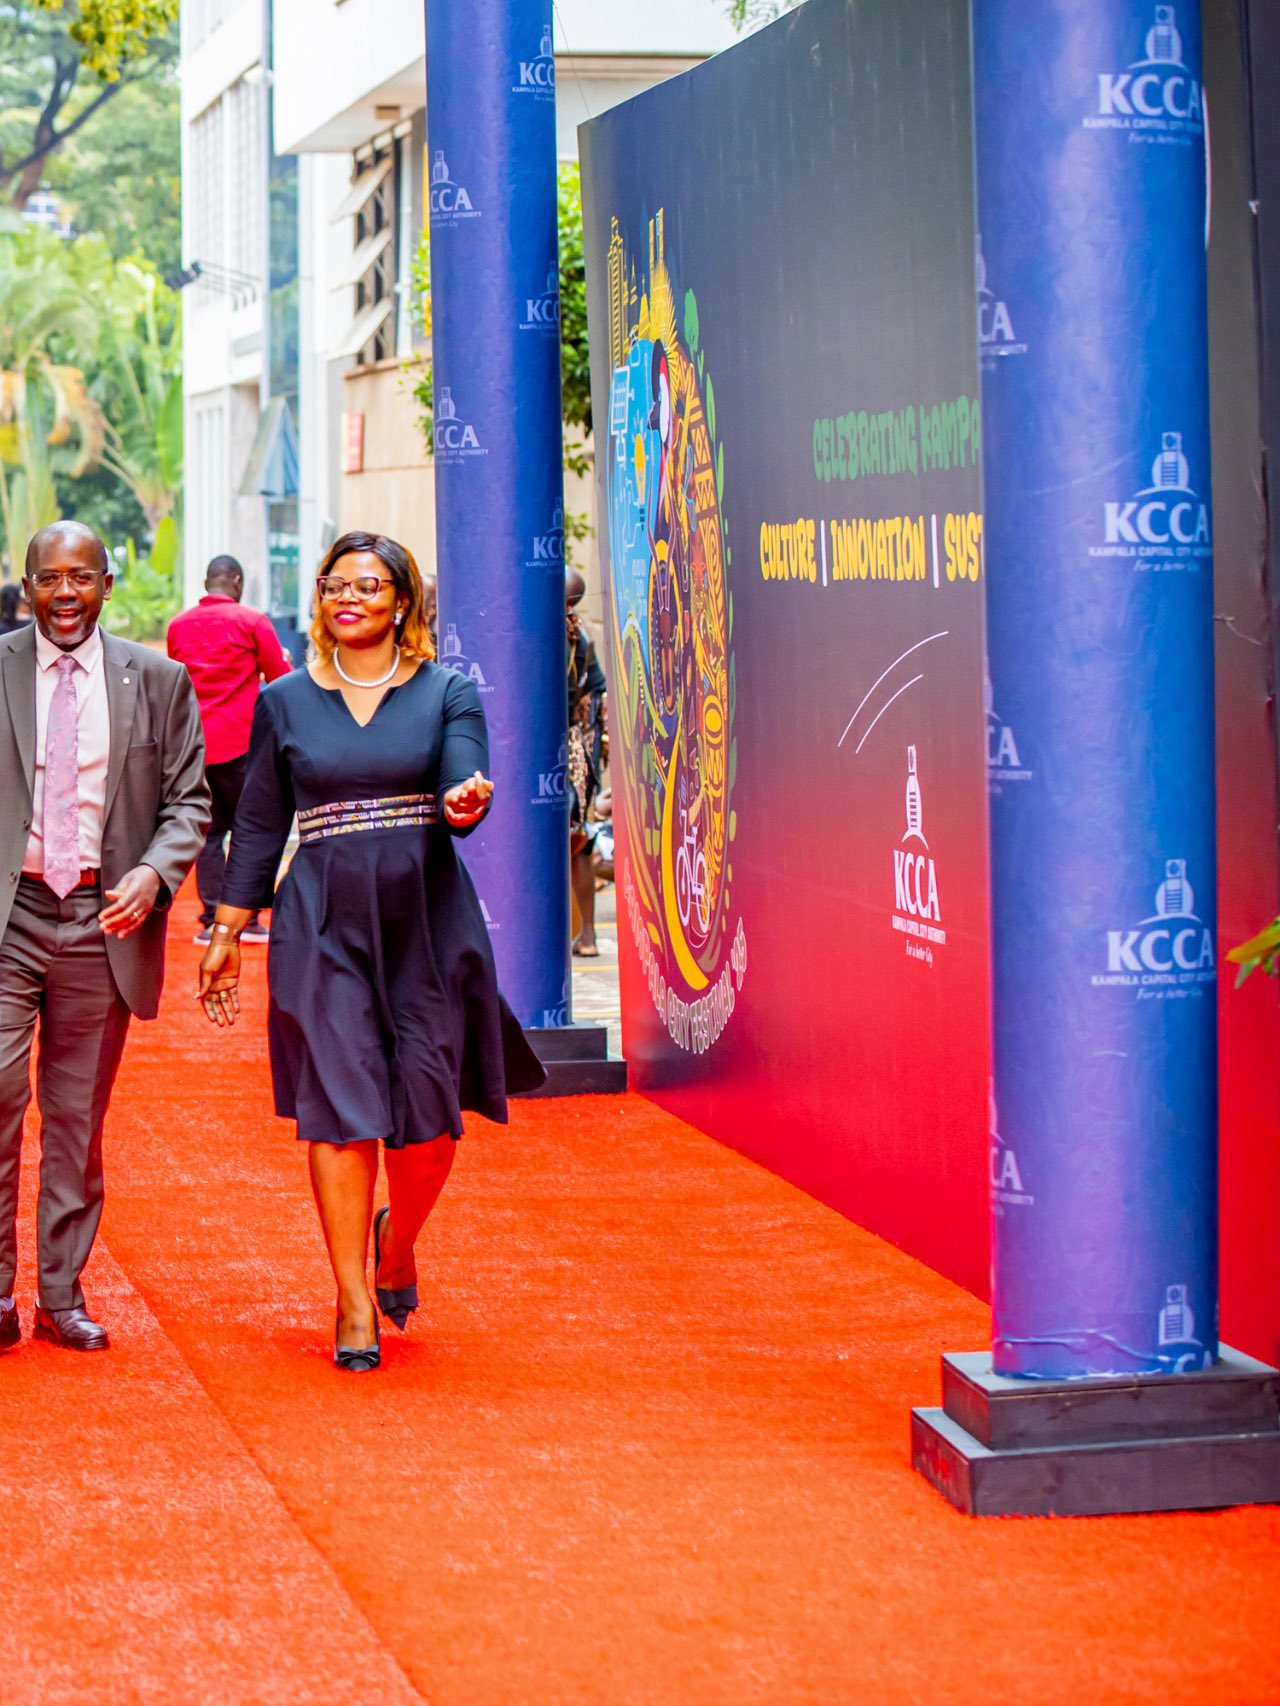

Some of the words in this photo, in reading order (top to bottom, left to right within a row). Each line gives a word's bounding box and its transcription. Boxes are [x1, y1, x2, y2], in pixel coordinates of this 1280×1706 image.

[519, 62, 554, 87] KCC
[1098, 73, 1201, 118] KCCA
[430, 188, 473, 212] CCA
[527, 299, 559, 321] KCC
[977, 301, 1016, 342] CA
[435, 425, 480, 449] CCA
[814, 404, 917, 482] CELEBRATING
[920, 395, 980, 472] KAMPA
[1104, 501, 1209, 544] KCCA
[533, 535, 564, 559] KCC
[760, 518, 817, 583] CULTURE
[830, 515, 926, 581] INNOVATION
[985, 725, 1021, 767] CA
[538, 772, 568, 796] KCC
[894, 850, 941, 922] KCCA
[1107, 928, 1214, 971] KCCA
[990, 1147, 1024, 1190] CA
